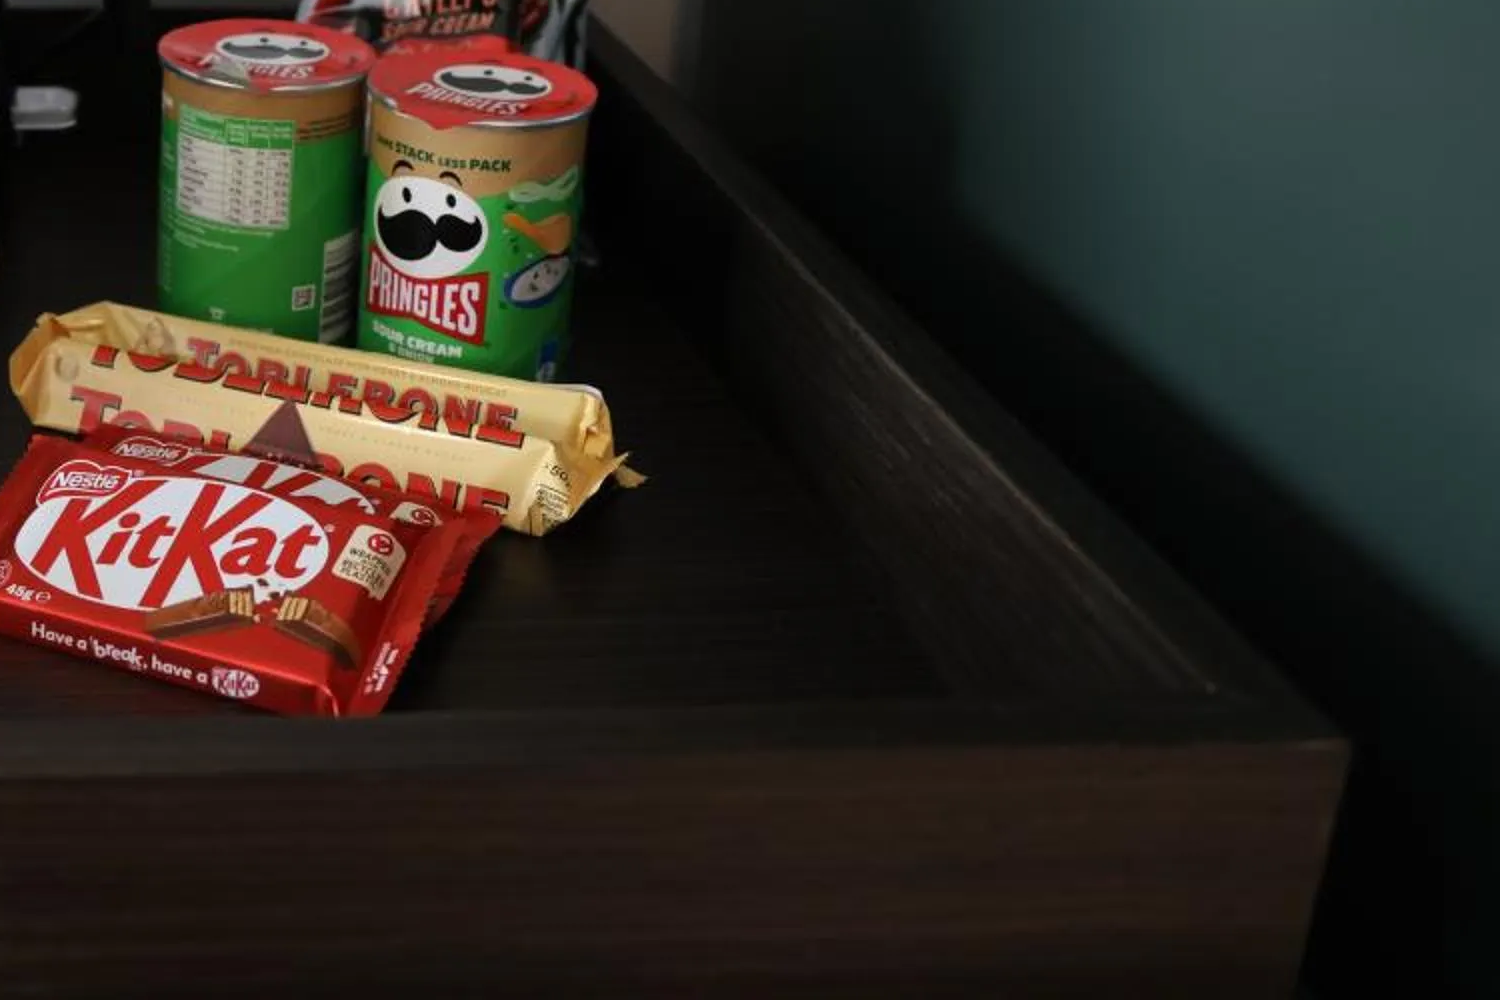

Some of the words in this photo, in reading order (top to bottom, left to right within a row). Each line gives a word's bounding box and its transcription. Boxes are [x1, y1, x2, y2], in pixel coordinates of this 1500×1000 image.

[428, 12, 494, 36] CREAM
[404, 81, 528, 115] PRINGLES
[395, 139, 434, 164] STACK
[437, 156, 466, 169] LESS
[469, 159, 512, 172] PACK
[369, 249, 480, 337] PRINGLES
[373, 319, 405, 345] SOUR
[406, 336, 463, 358] CREAM
[30, 477, 322, 608] KitKat
[6, 583, 35, 601] 45g
[31, 620, 74, 647] Have
[76, 639, 87, 651] a
[151, 654, 192, 680] have
[196, 671, 208, 685] a
